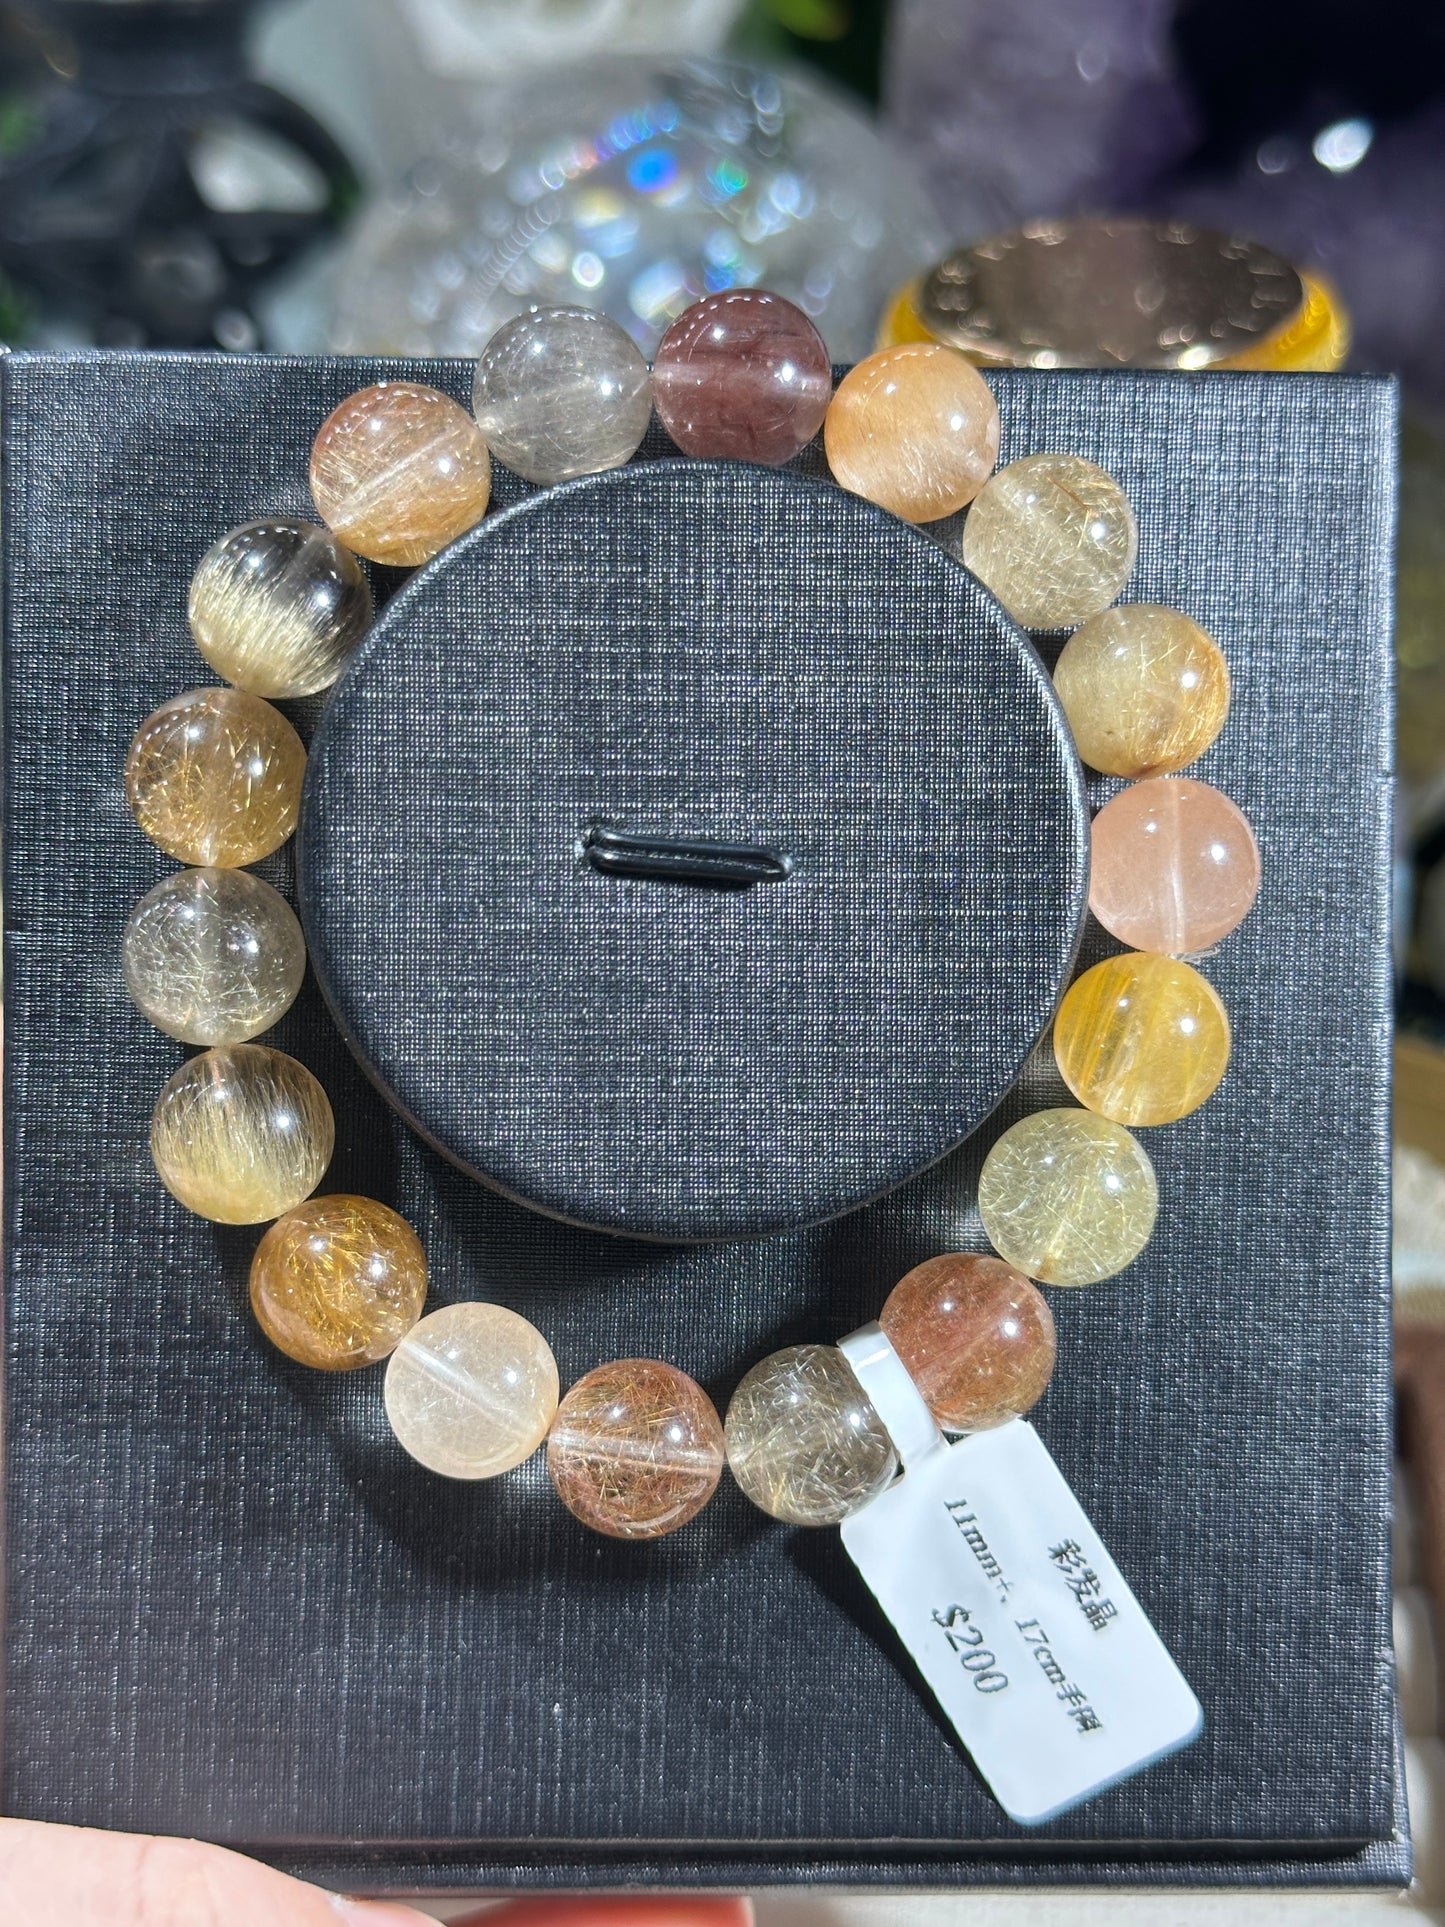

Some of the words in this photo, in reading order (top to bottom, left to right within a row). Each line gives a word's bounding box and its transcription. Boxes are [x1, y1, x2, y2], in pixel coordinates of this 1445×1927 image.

[1047, 1538, 1118, 1632] 彩发晶
[930, 1603, 1009, 1694] $200
